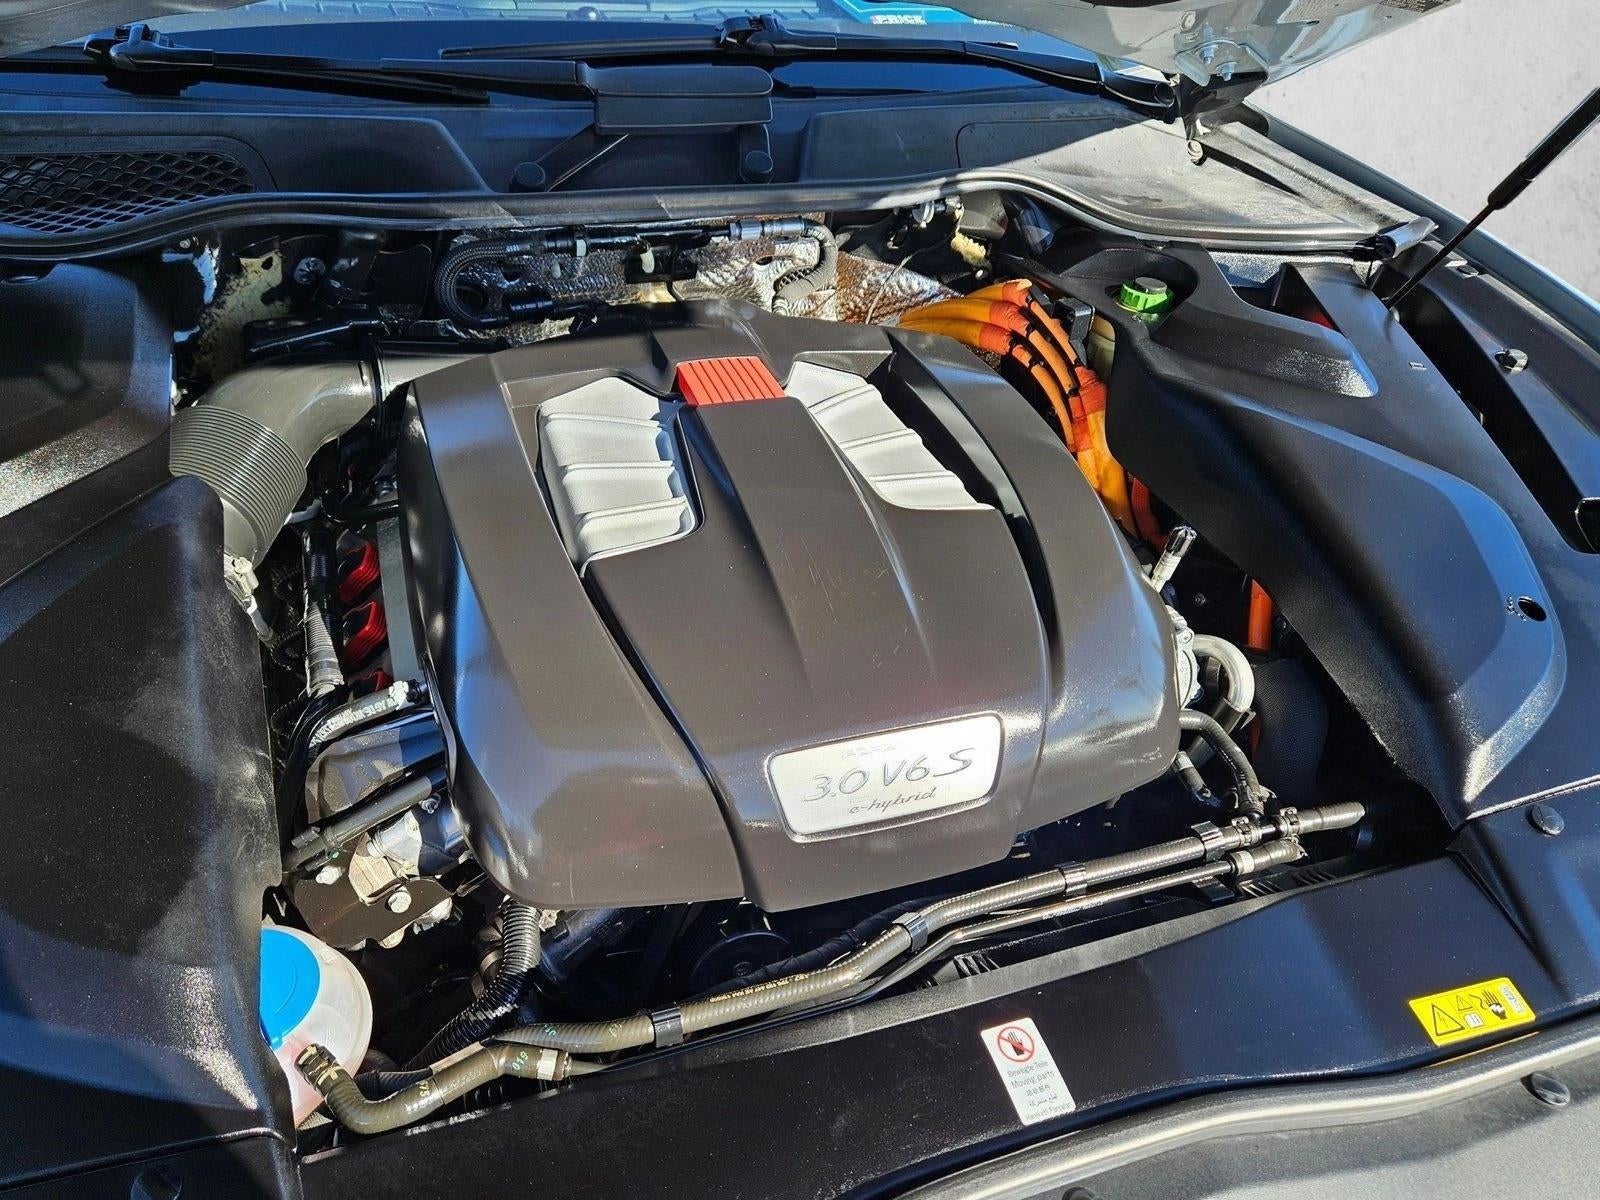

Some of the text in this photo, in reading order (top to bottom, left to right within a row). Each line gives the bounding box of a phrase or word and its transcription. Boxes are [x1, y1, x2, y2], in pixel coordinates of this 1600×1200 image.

[804, 768, 869, 801] 3.0
[849, 787, 937, 814] e-hybrid
[1011, 1071, 1055, 1089] Moving parts
